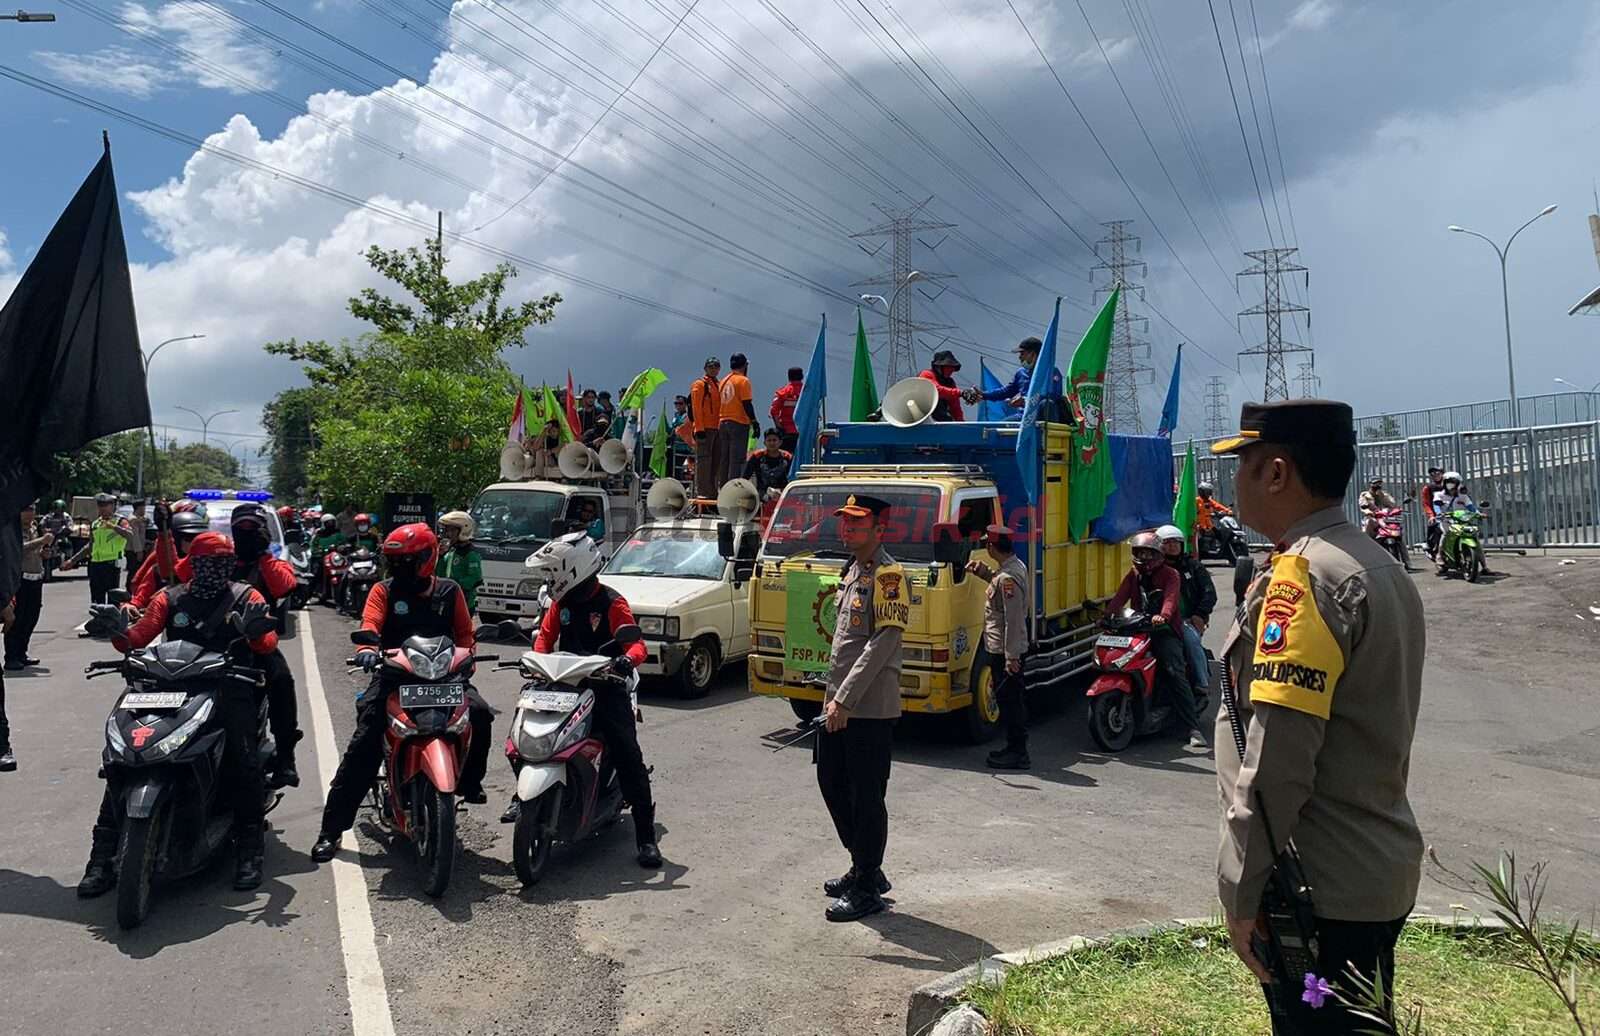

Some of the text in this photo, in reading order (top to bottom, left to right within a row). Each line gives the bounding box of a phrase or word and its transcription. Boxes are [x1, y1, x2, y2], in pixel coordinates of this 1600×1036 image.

[791, 648, 814, 661] FSP.
[402, 687, 410, 696] W
[416, 686, 441, 696] 6756
